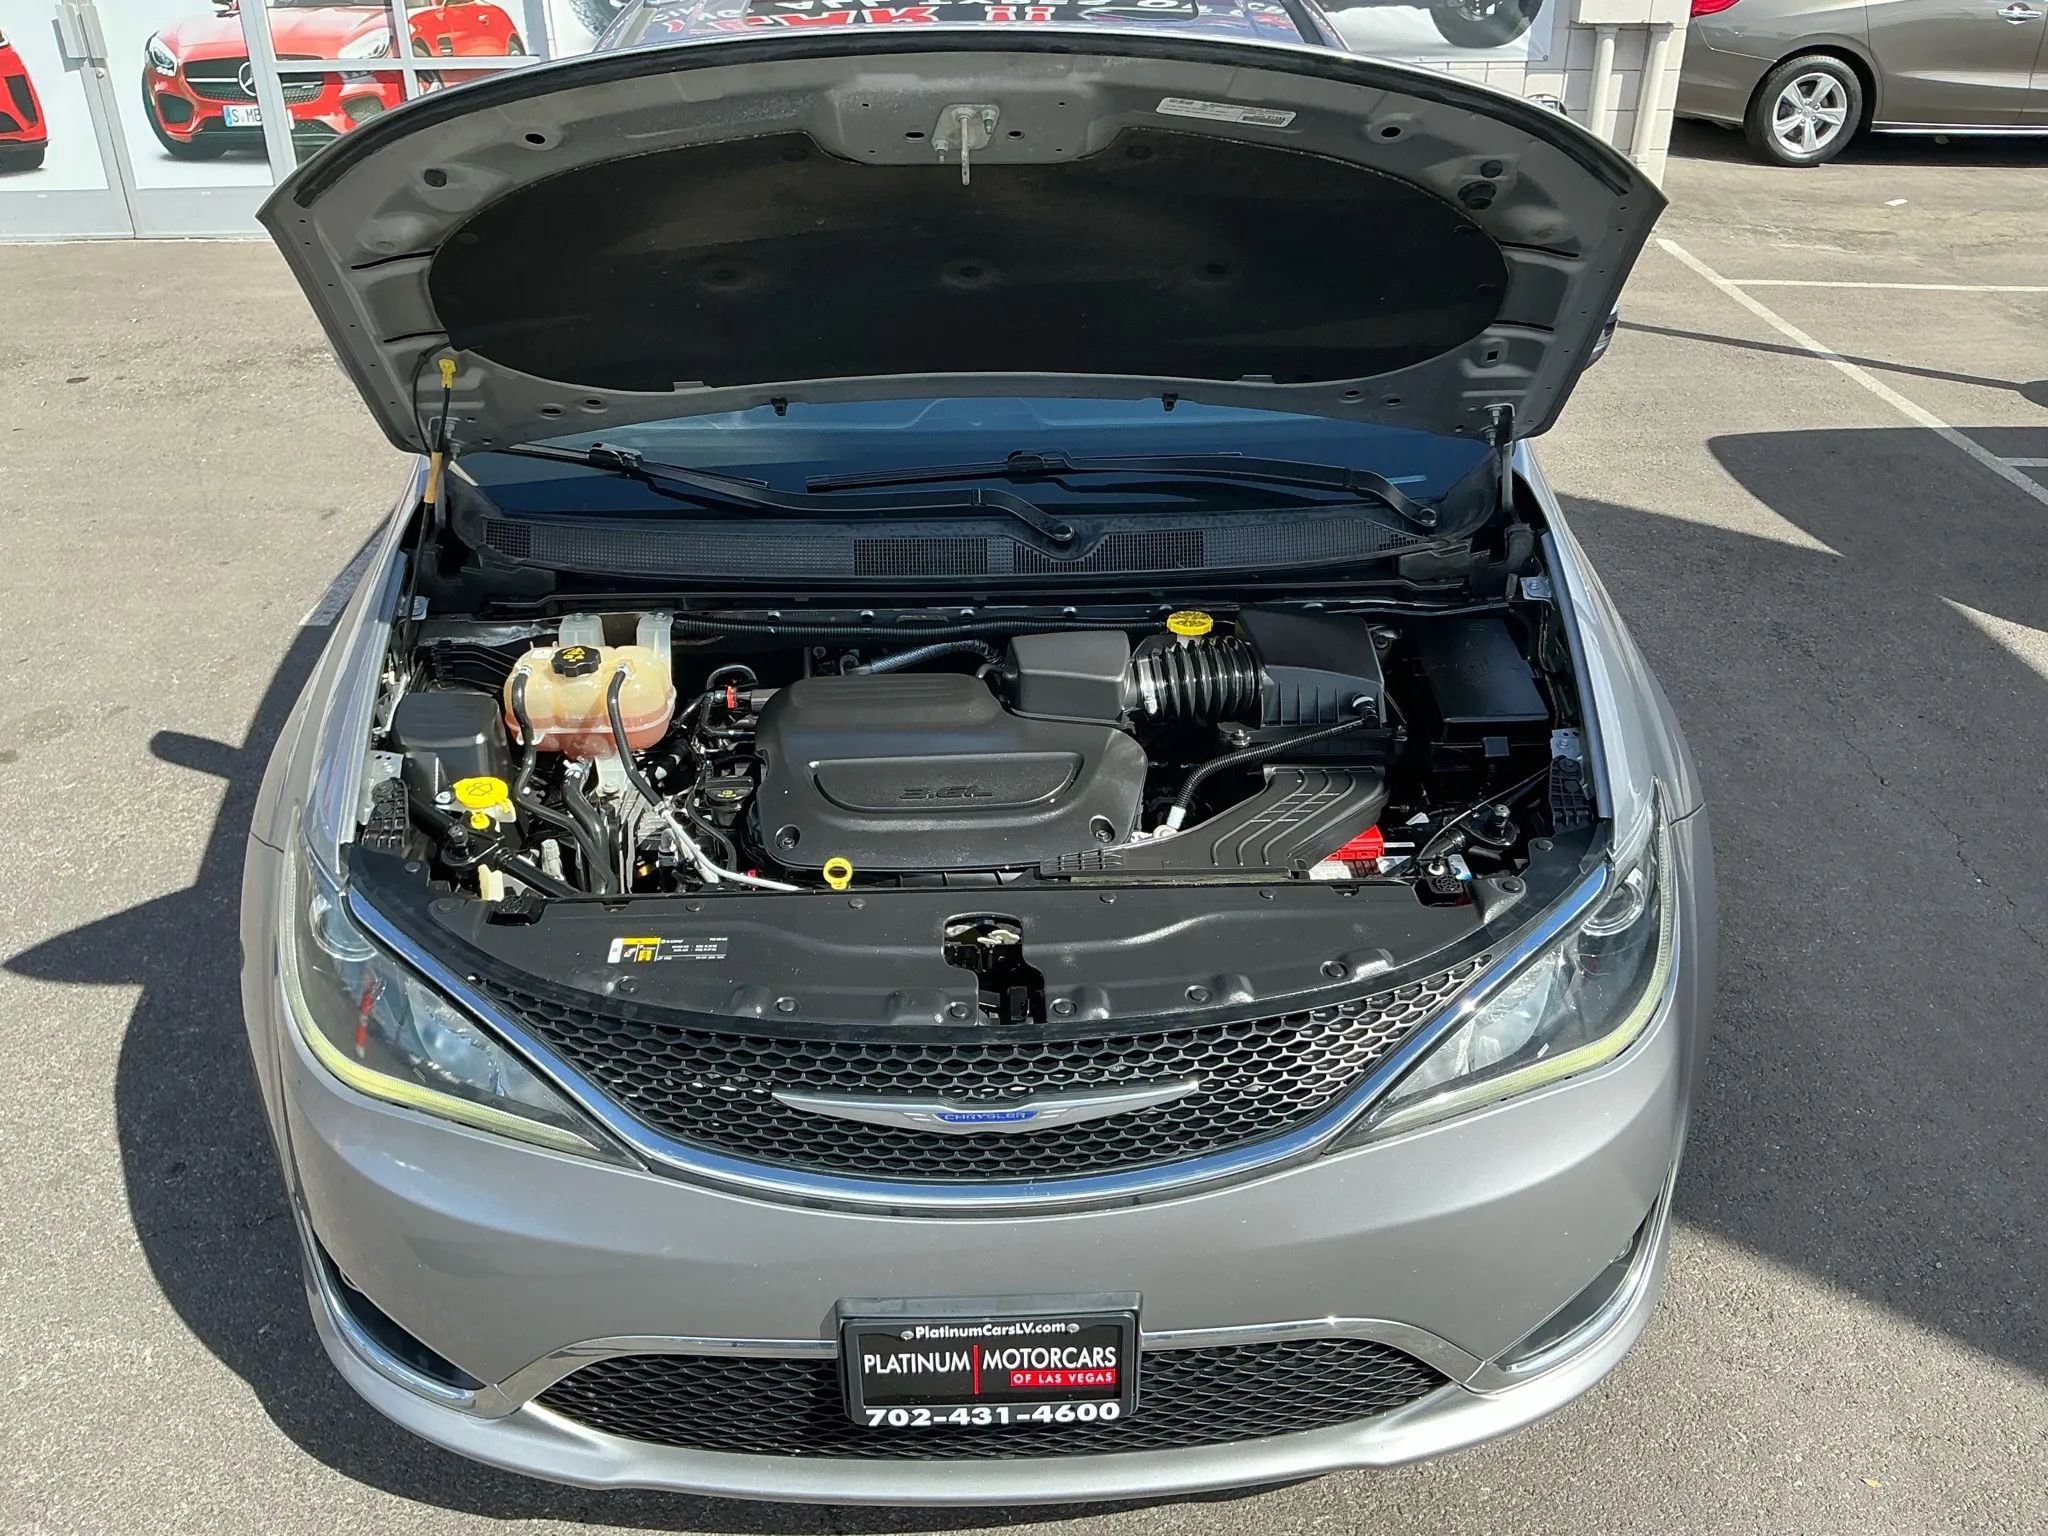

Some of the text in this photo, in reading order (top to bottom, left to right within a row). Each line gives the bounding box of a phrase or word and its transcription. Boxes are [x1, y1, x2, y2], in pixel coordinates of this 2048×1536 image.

[944, 1112, 1026, 1121] CHRYSLER
[915, 1322, 1066, 1339] PlatinumCarsLV.com
[863, 1346, 1117, 1374] PLATINUM MOTORCARS
[1013, 1371, 1113, 1383] OF LAS VEGAS
[865, 1402, 1120, 1427] 702-431-4600
